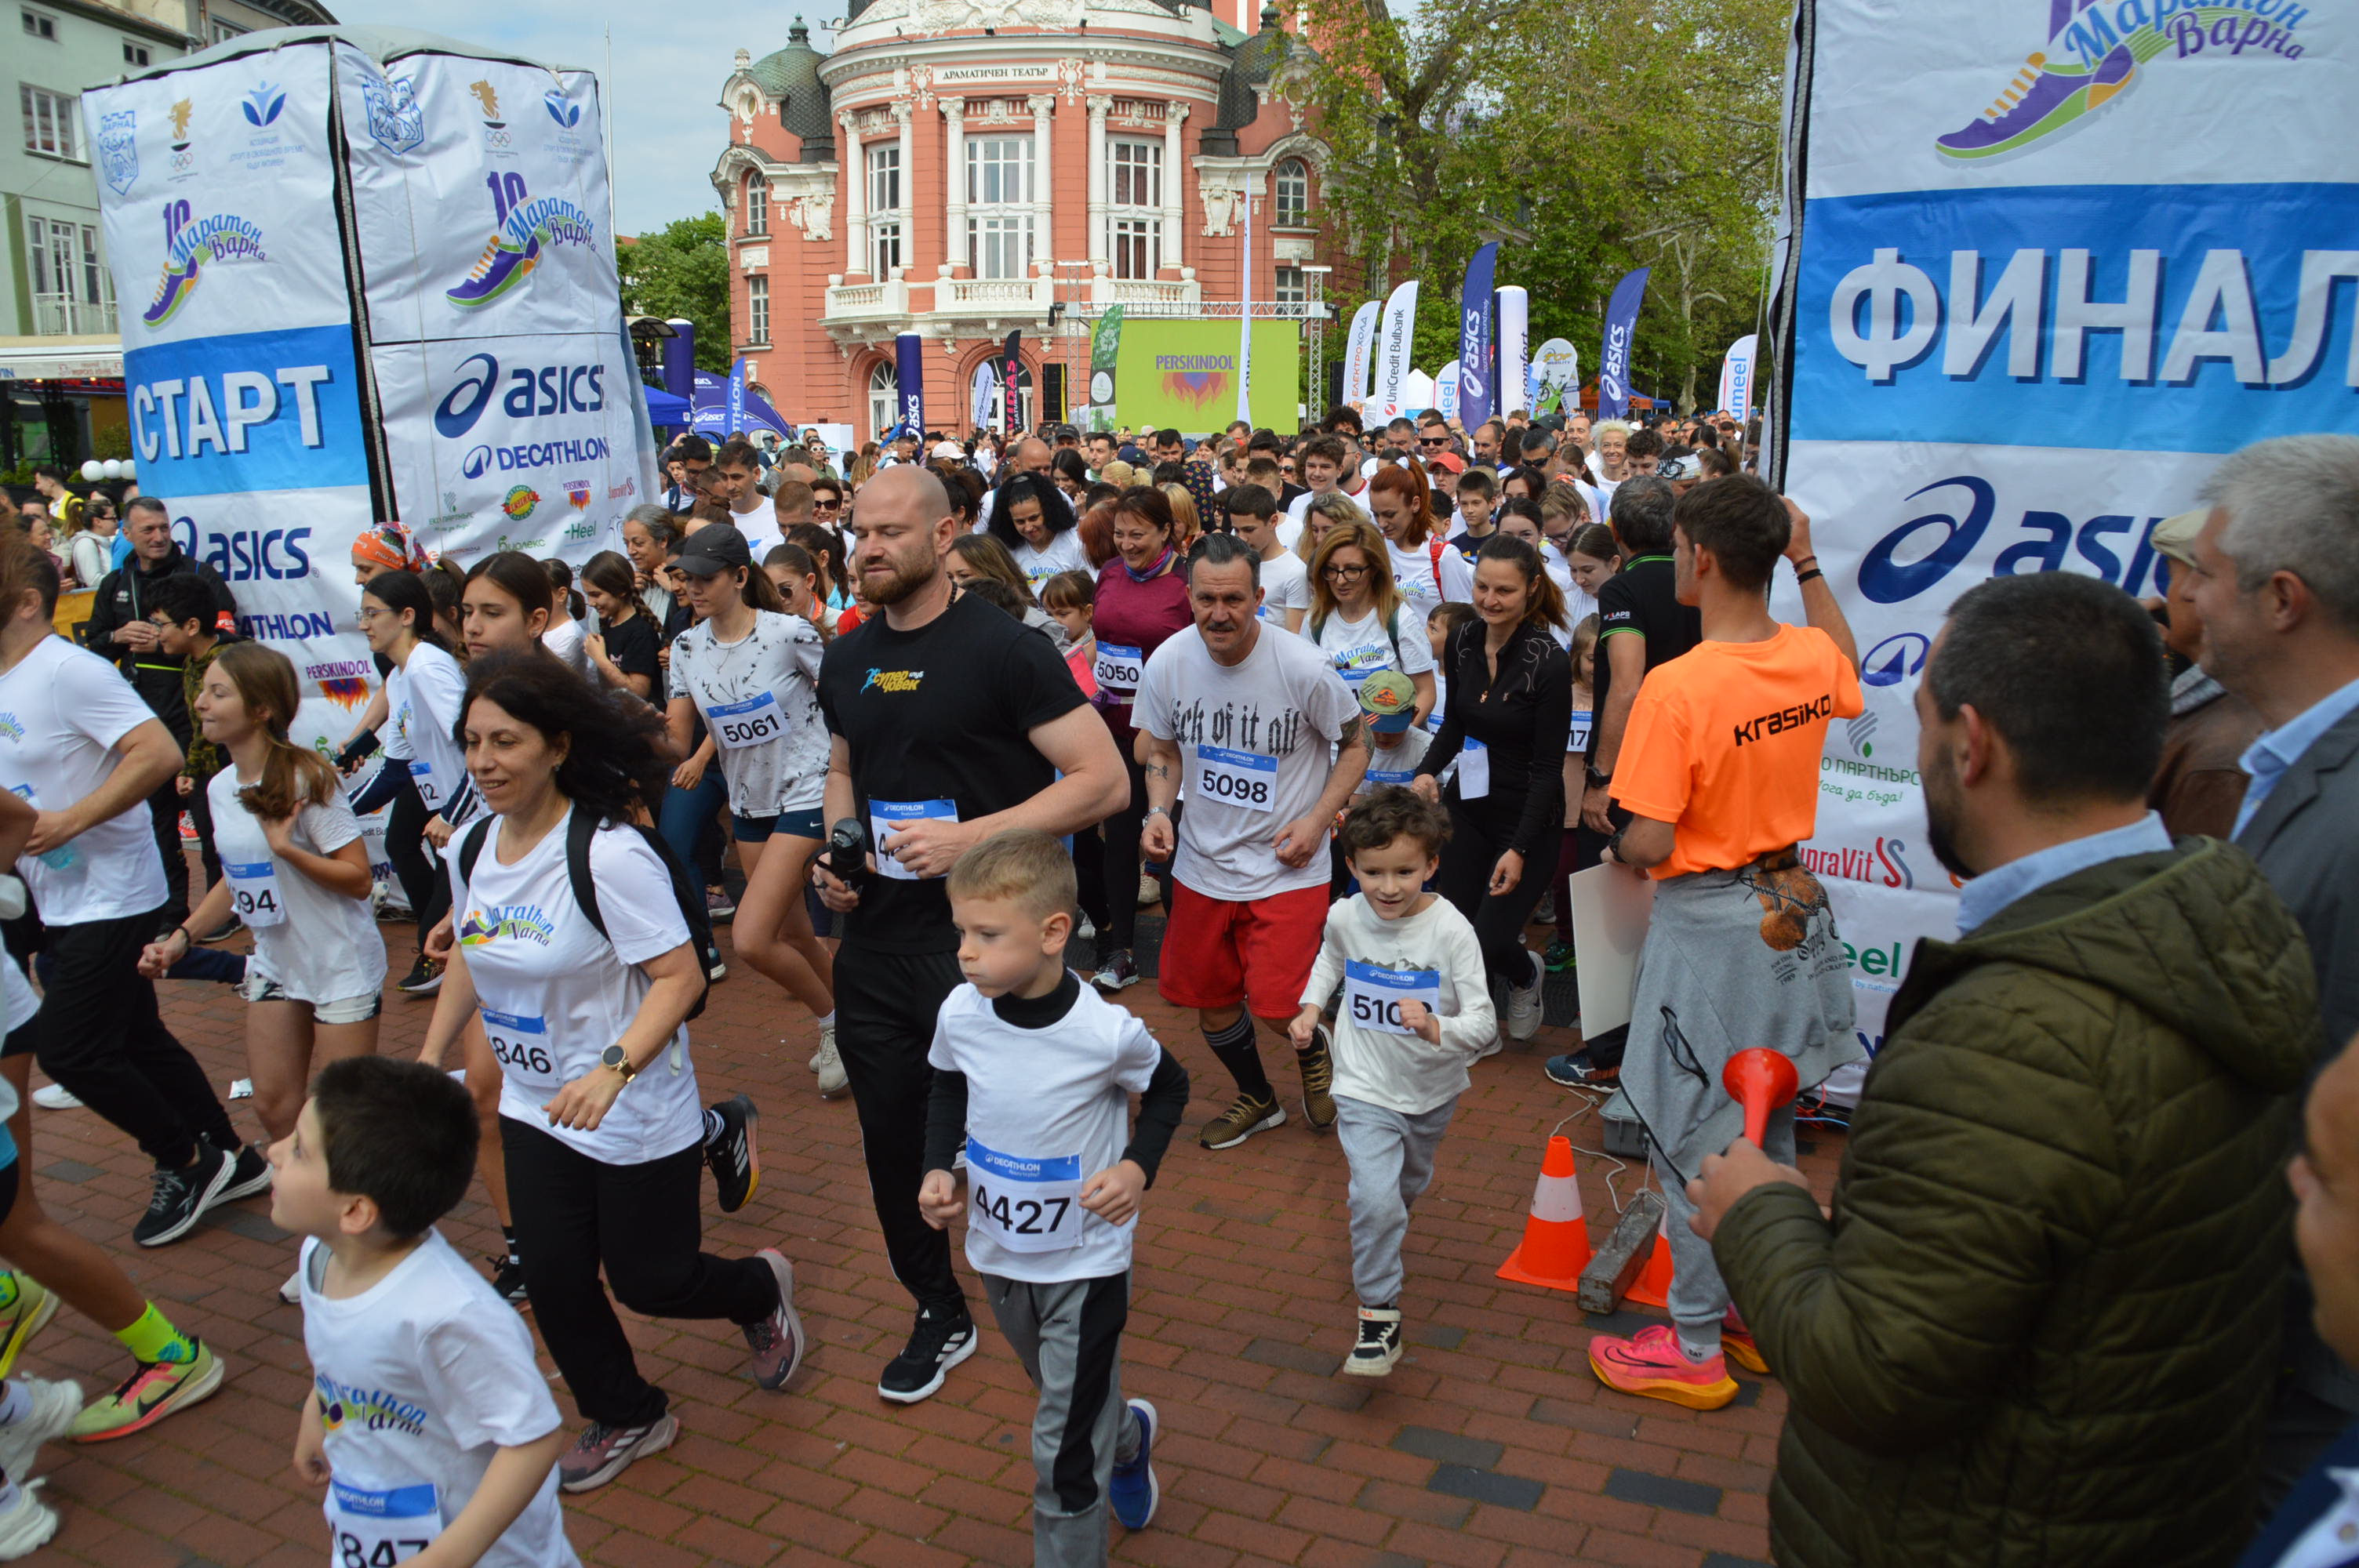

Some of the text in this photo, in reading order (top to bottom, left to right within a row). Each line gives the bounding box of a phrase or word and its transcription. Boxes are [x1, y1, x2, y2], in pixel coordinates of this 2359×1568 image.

[2165, 11, 2305, 60] Варна
[943, 67, 1049, 79] ДРАМАТИЧЕН ТЕАТЪР
[507, 196, 594, 249] Маратон
[548, 217, 596, 252] Варна
[172, 214, 263, 267] Маратон
[208, 234, 267, 262] Варна
[1830, 248, 2359, 384] ФИНАЛ
[1387, 309, 1405, 402] UniCredit Bulbank
[1465, 308, 1480, 369] asics
[1606, 324, 1624, 376] asics
[1156, 355, 1234, 370] PERSKINDOL
[503, 365, 605, 418] asics
[134, 365, 333, 461] СТАРТ
[908, 394, 920, 428] asics
[497, 437, 610, 470] DECATHLON
[563, 480, 591, 492] PERSKINDOL
[209, 528, 311, 581] asics
[306, 659, 371, 681] PERSKINDOL
[1336, 643, 1385, 664] Marathon
[1098, 661, 1140, 683] 5050
[723, 713, 780, 742] 5061
[1212, 702, 1234, 750] of
[1241, 702, 1259, 750] it
[1268, 707, 1300, 755] all
[1203, 769, 1268, 804] 5098
[1817, 780, 1903, 807] ога да бъда!
[507, 920, 551, 948] Varna
[487, 1035, 551, 1074] 846
[994, 1158, 1041, 1171] DECATHLON
[976, 1184, 1070, 1234] 4427
